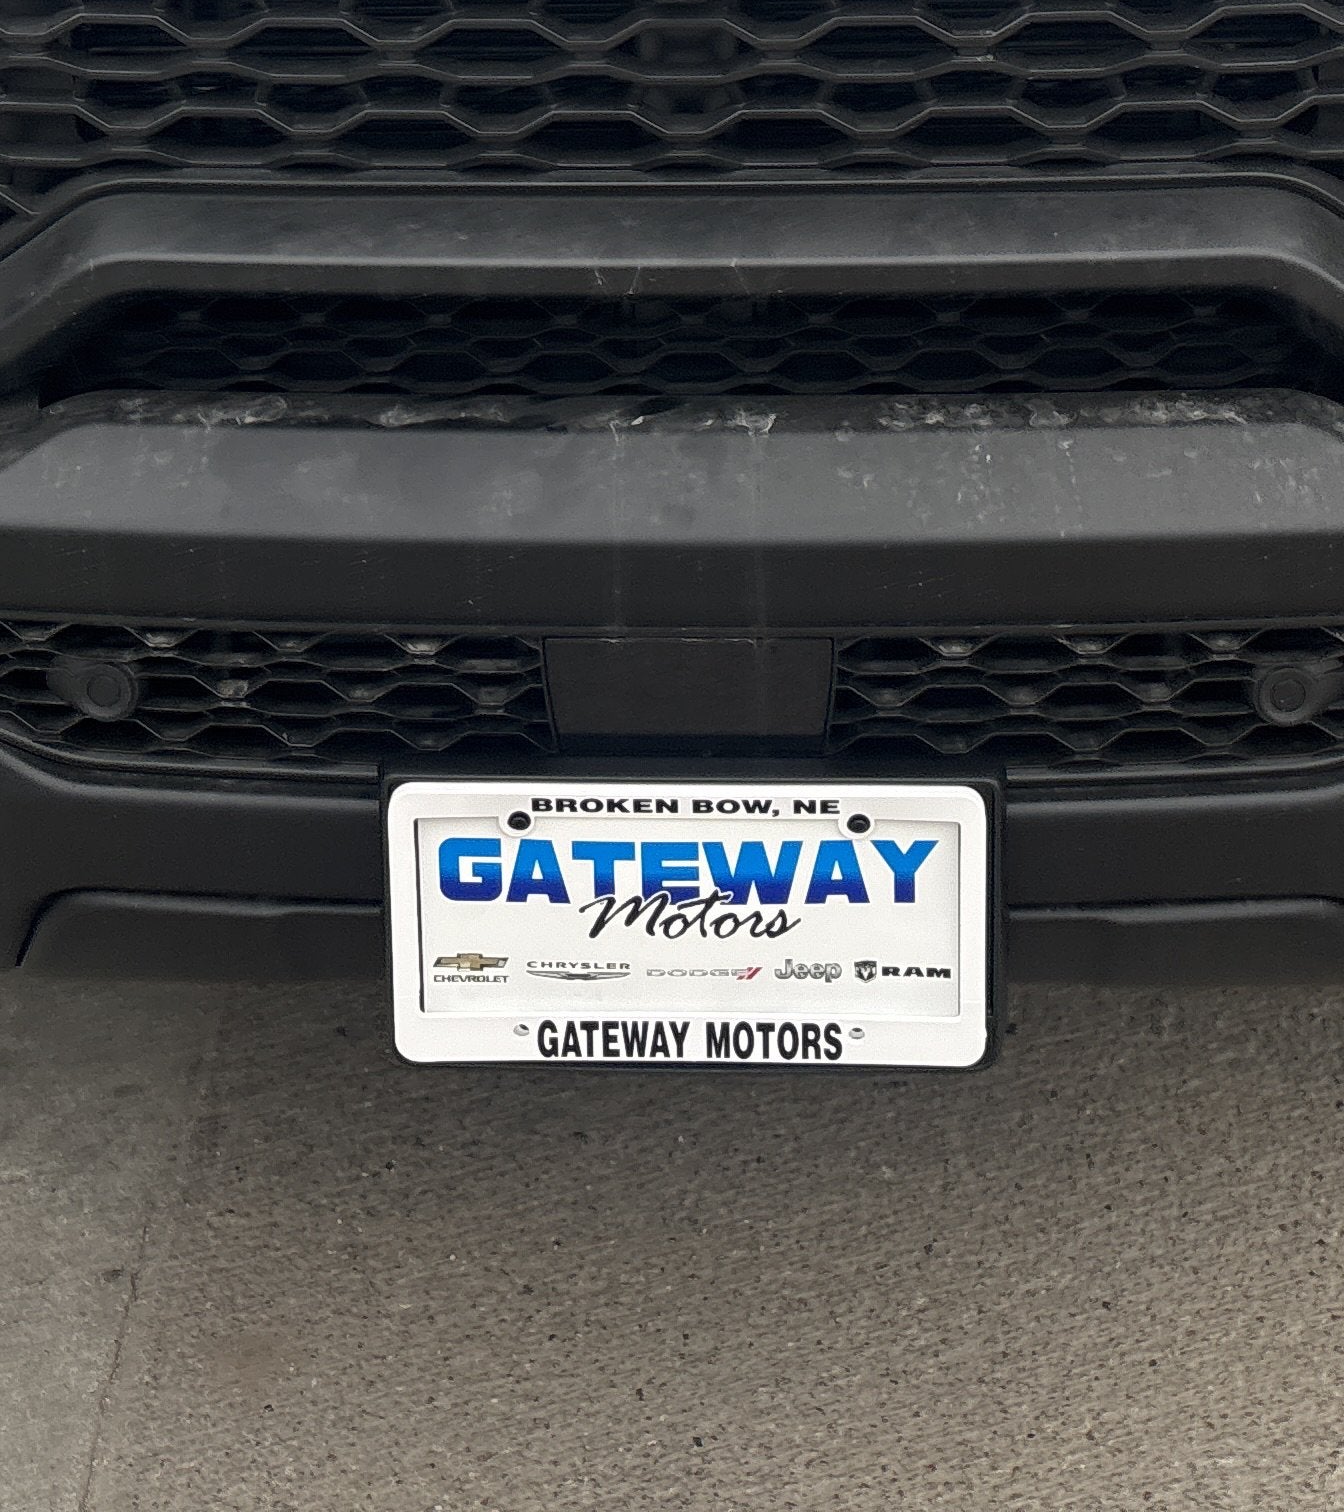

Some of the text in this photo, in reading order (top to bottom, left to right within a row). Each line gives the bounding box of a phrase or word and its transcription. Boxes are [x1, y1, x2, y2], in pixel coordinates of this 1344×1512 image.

[531, 798, 841, 817] BROKEN BOW, NE
[438, 837, 940, 906] GATEWAY
[578, 888, 803, 940] Motors
[526, 960, 632, 970] CHRYSLER
[646, 967, 747, 977] DODGE
[774, 959, 843, 983] Jeep
[881, 965, 952, 979] RAM
[433, 974, 510, 984] CHEVROLET
[536, 1019, 844, 1061] GATEWAY MOTORS
